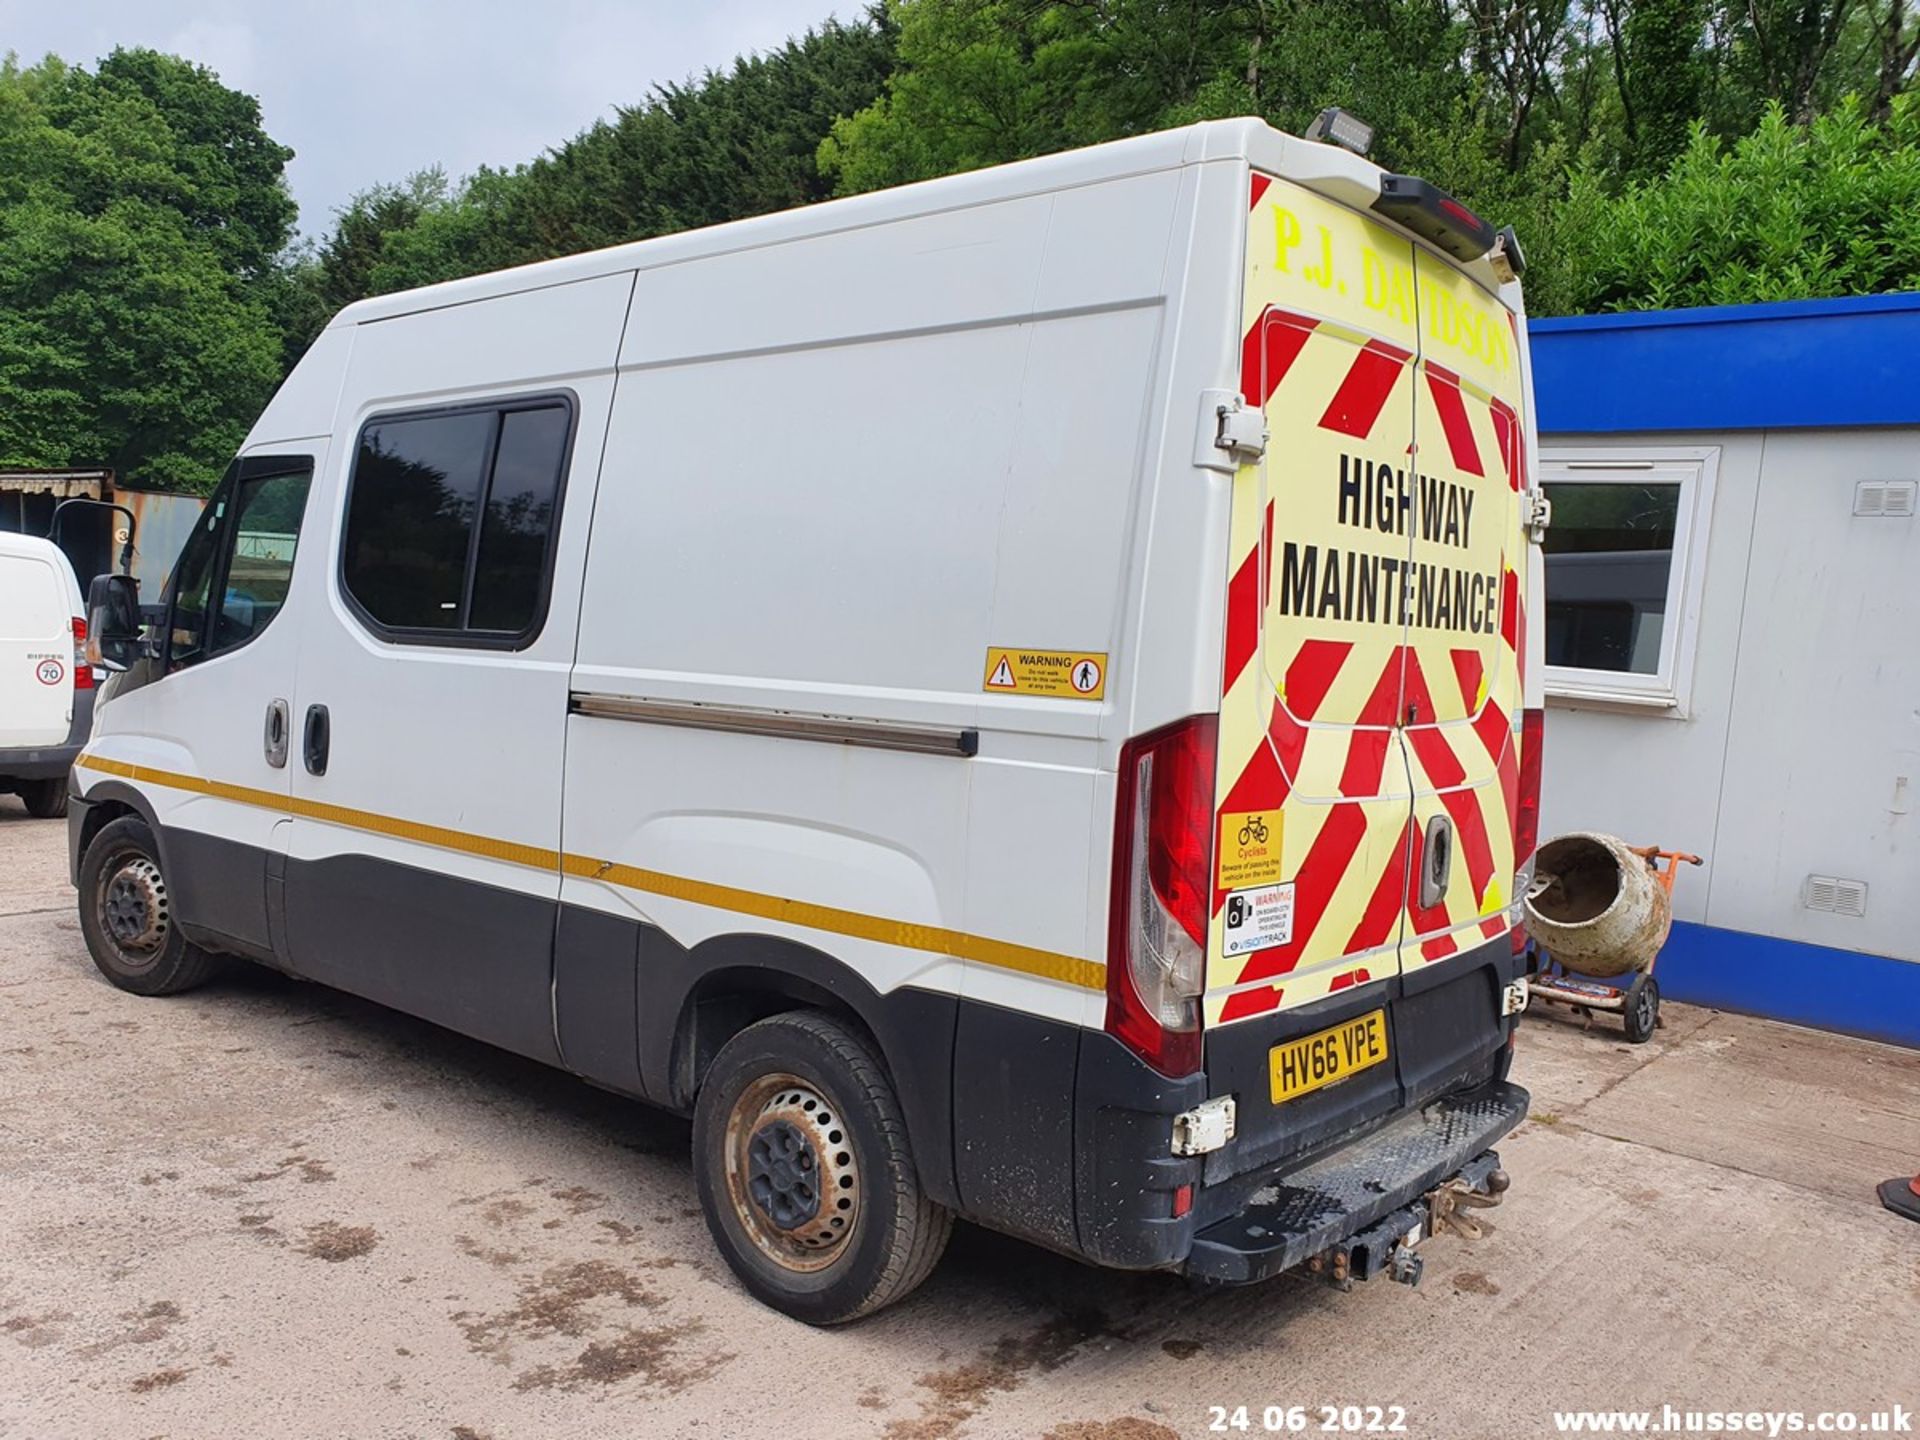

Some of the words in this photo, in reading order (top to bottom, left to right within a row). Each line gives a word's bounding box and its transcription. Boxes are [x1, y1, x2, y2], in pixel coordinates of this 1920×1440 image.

[1272, 203, 1347, 296] P.J.
[1360, 243, 1510, 374] DAVIDSON
[1337, 453, 1475, 549] HIGHWAY
[1279, 541, 1497, 634] MAINTENANCE
[1019, 655, 1072, 668] WARNING
[42, 669, 58, 679] 70
[1238, 847, 1268, 860] Cyclists
[1222, 863, 1242, 872] Beware
[1249, 860, 1270, 870] passing
[1223, 873, 1244, 881] vehicle
[1255, 890, 1292, 906] WARNING
[1281, 1035, 1338, 1092] HV66
[1343, 1018, 1379, 1067] VPE
